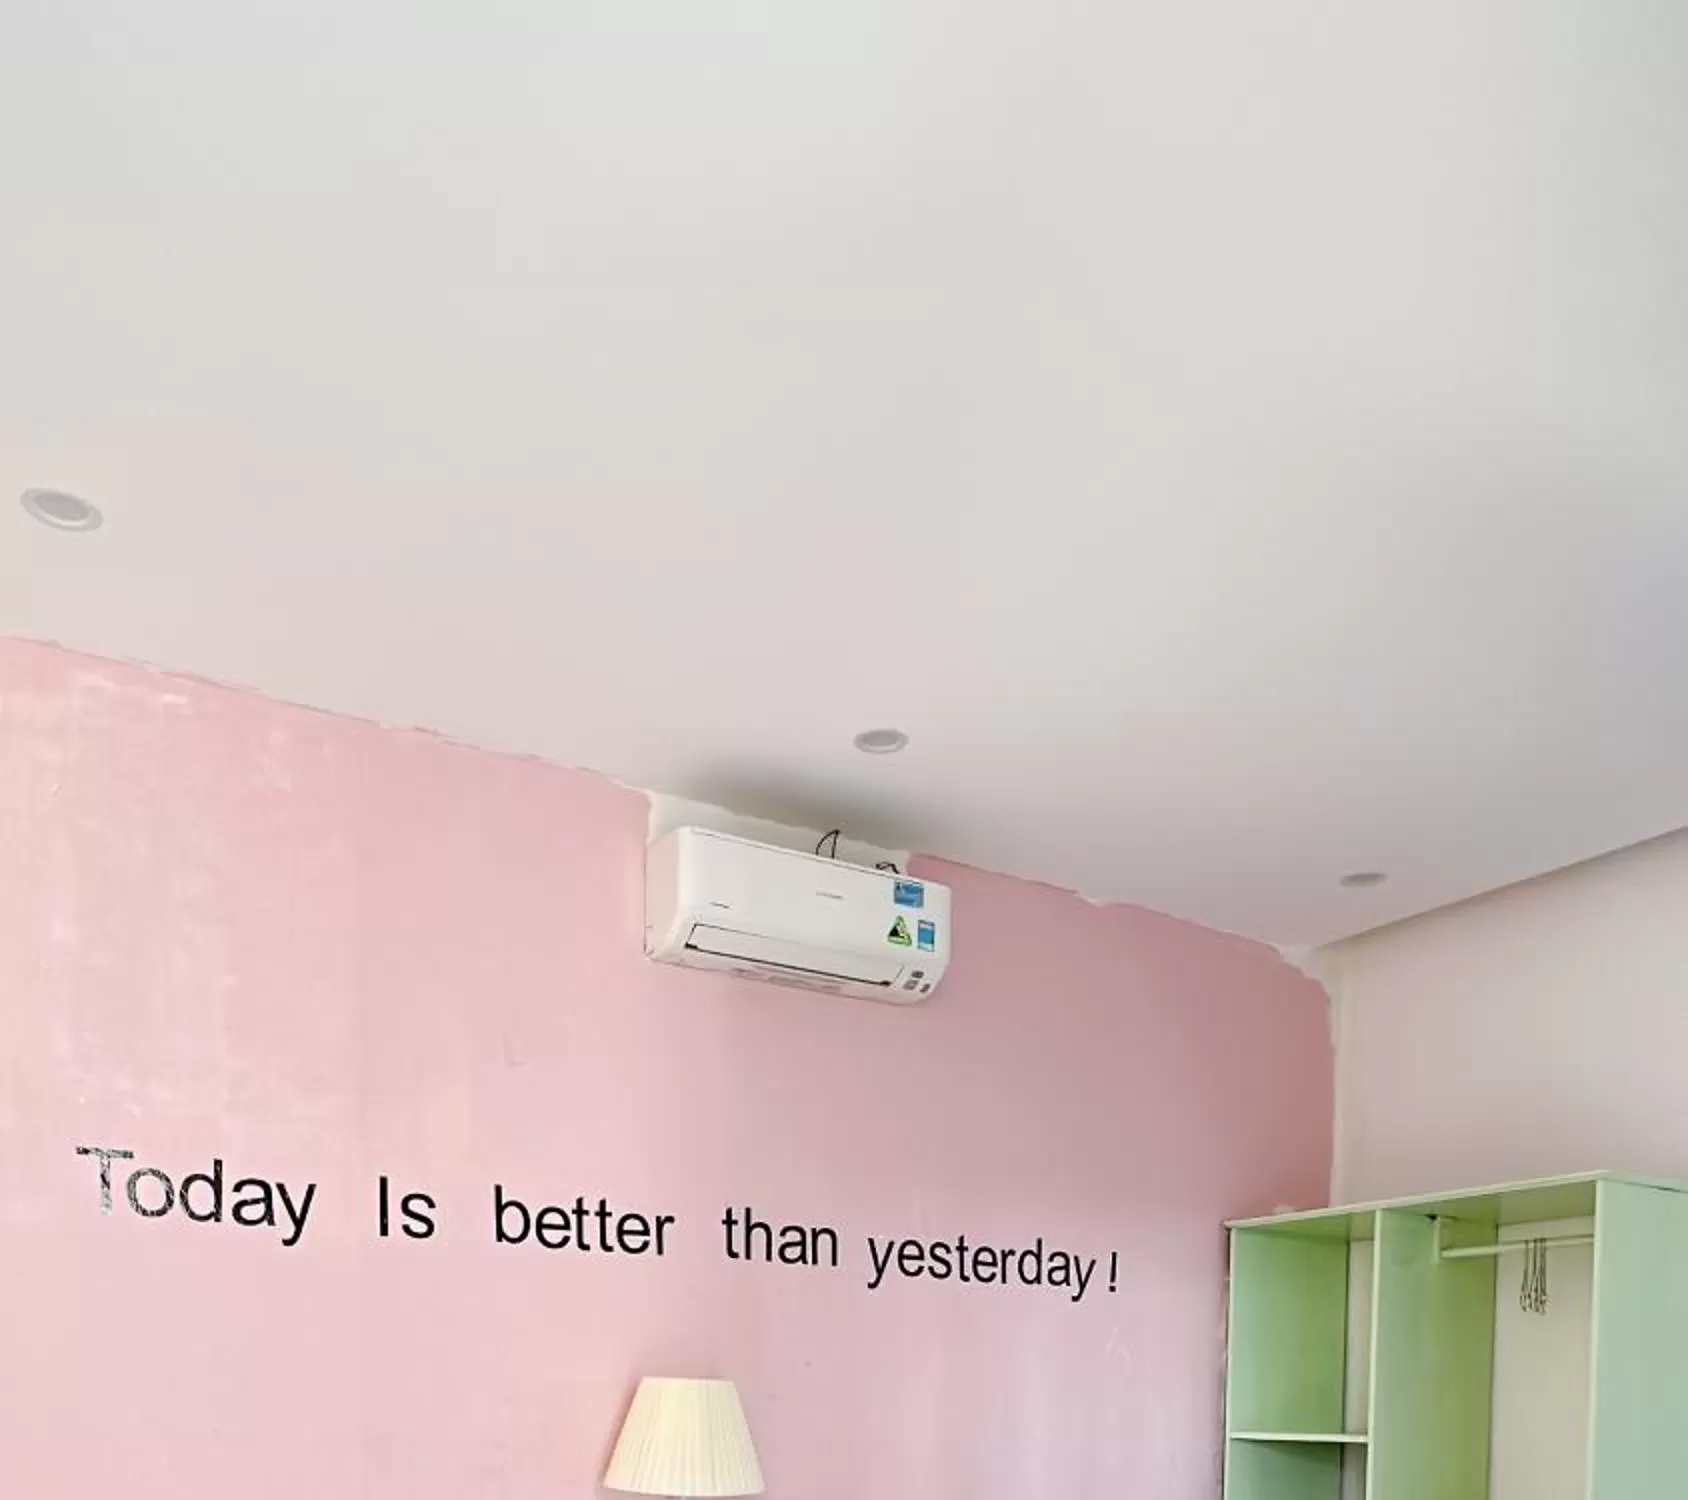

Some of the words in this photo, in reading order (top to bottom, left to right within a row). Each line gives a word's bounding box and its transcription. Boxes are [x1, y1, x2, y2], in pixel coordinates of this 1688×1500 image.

[76, 1146, 317, 1247] Today
[379, 1175, 437, 1239] Is
[494, 1184, 675, 1256] better
[721, 1206, 838, 1267] than
